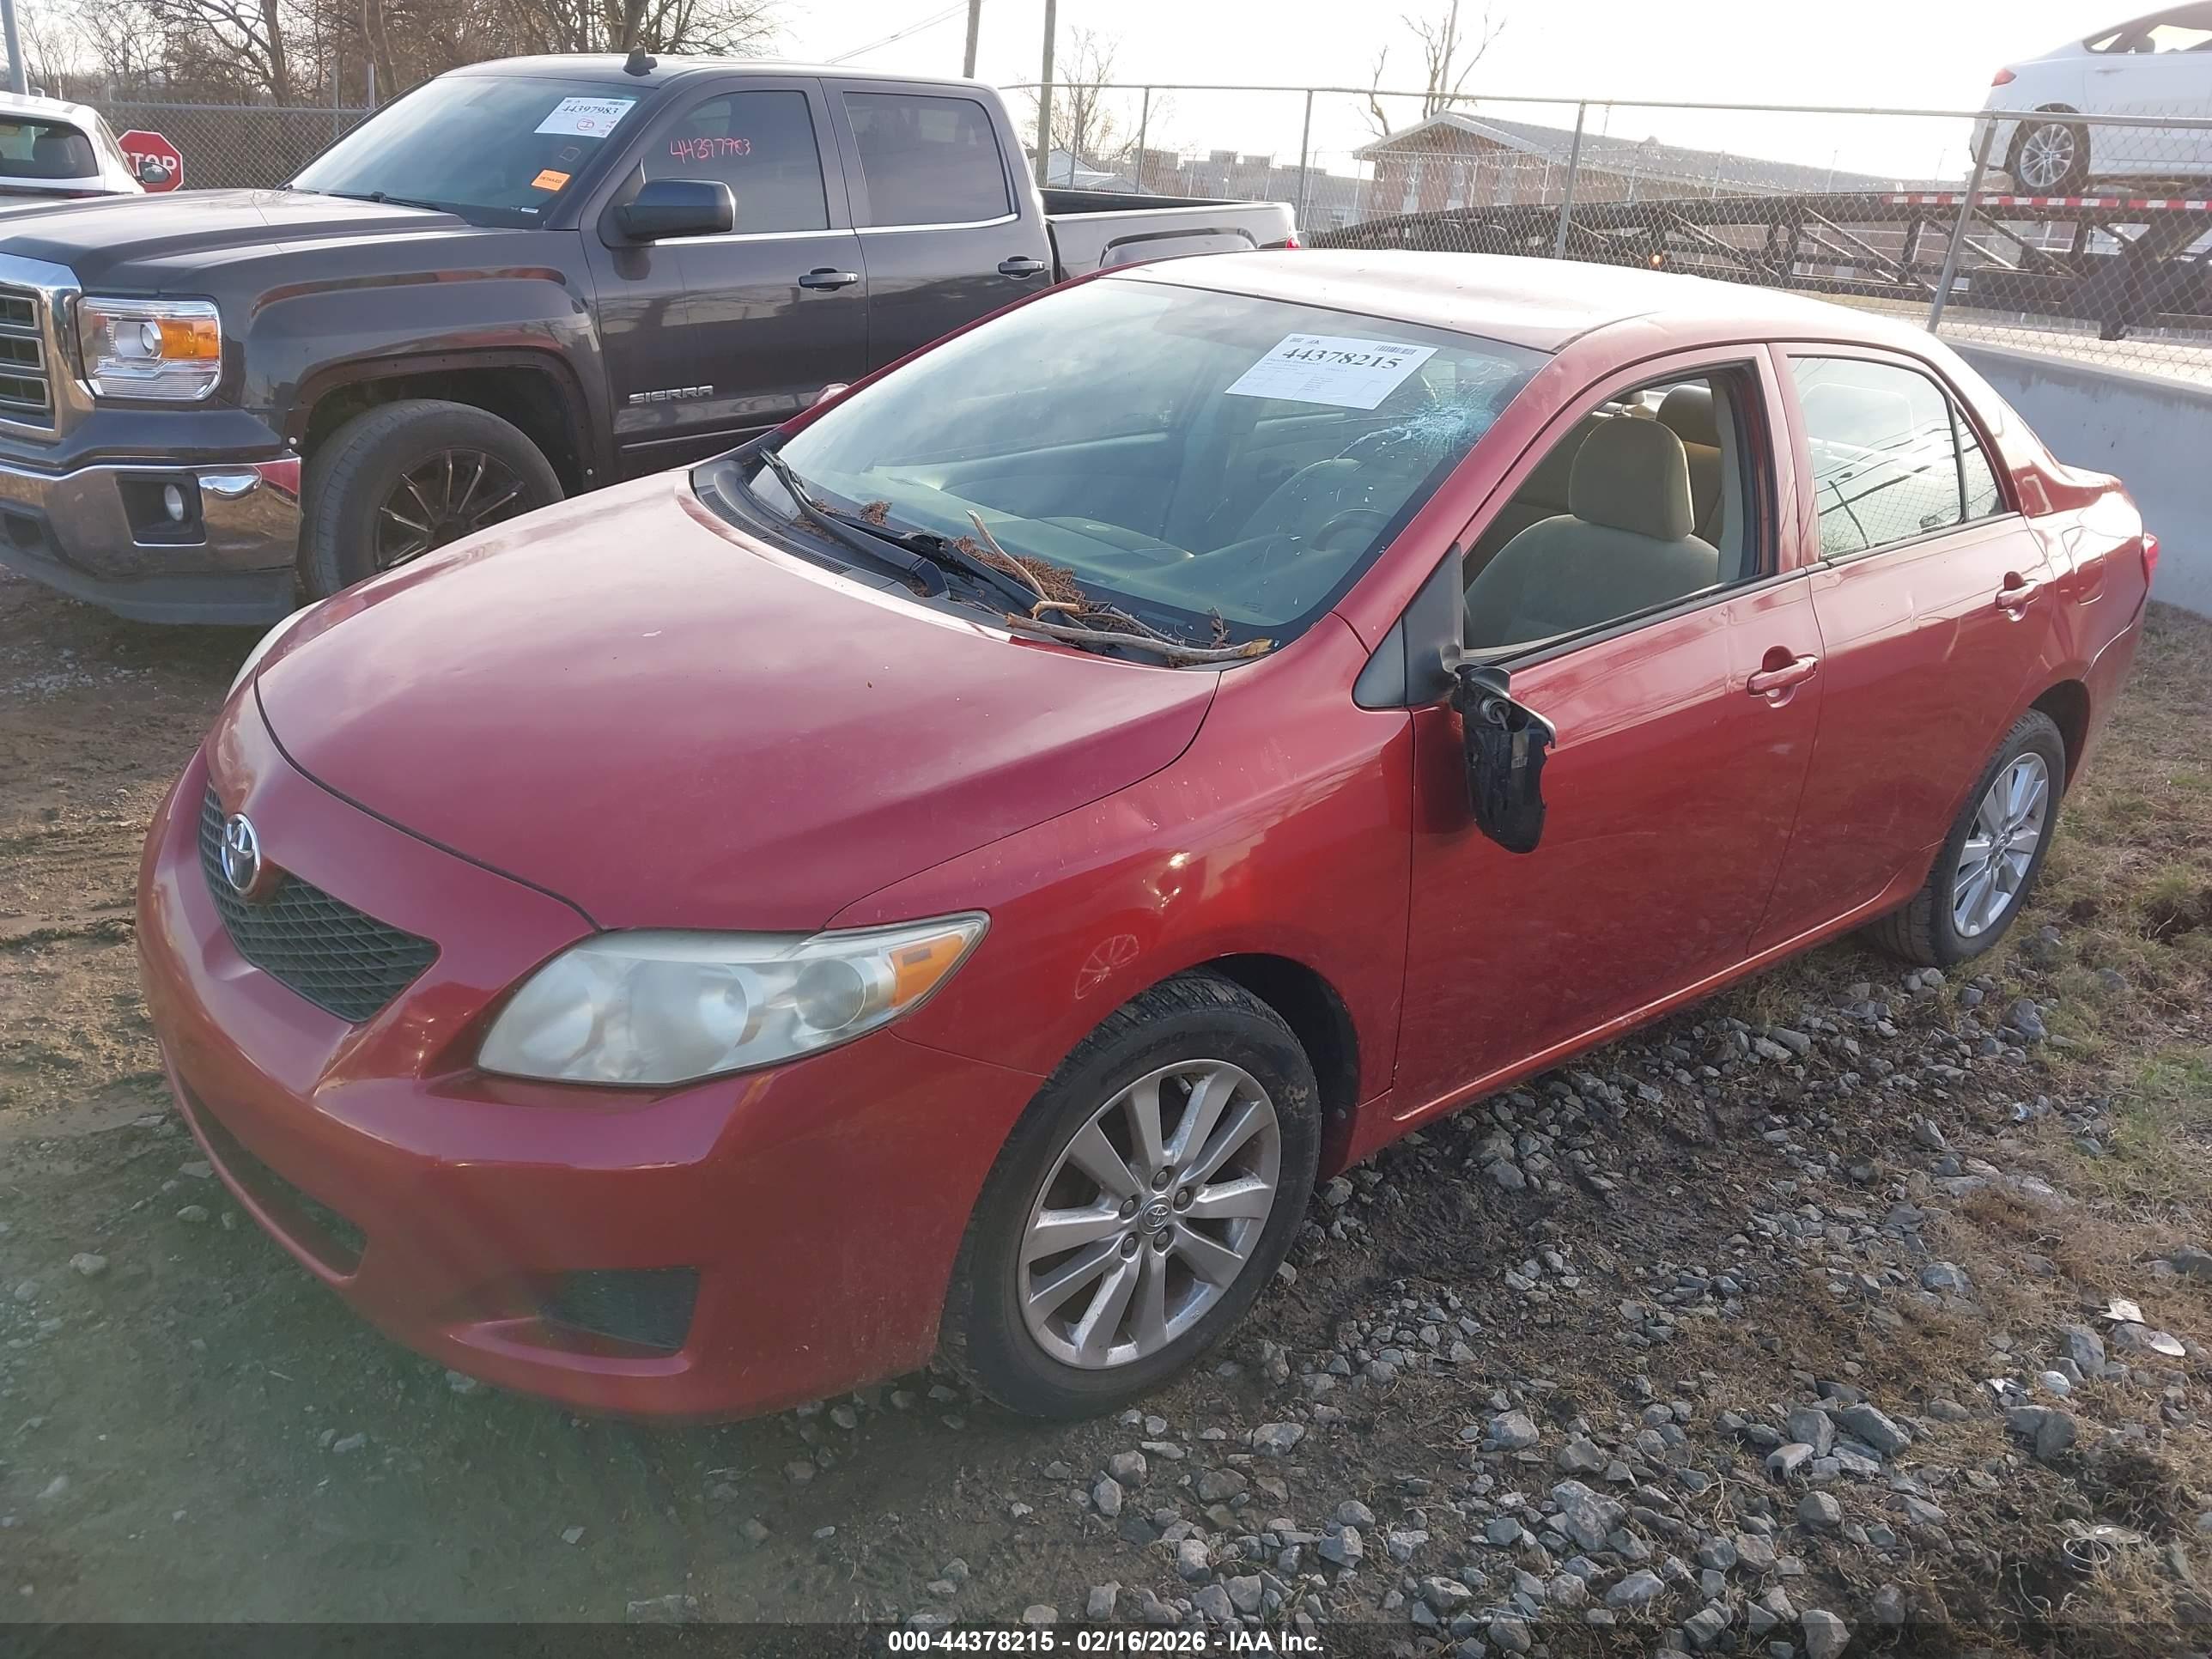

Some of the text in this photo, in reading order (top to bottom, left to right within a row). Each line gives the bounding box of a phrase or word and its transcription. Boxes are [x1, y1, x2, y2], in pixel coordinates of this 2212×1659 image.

[562, 105, 619, 115] 44397983
[1281, 347, 1404, 369] 44378215
[629, 385, 714, 404] SIERRA
